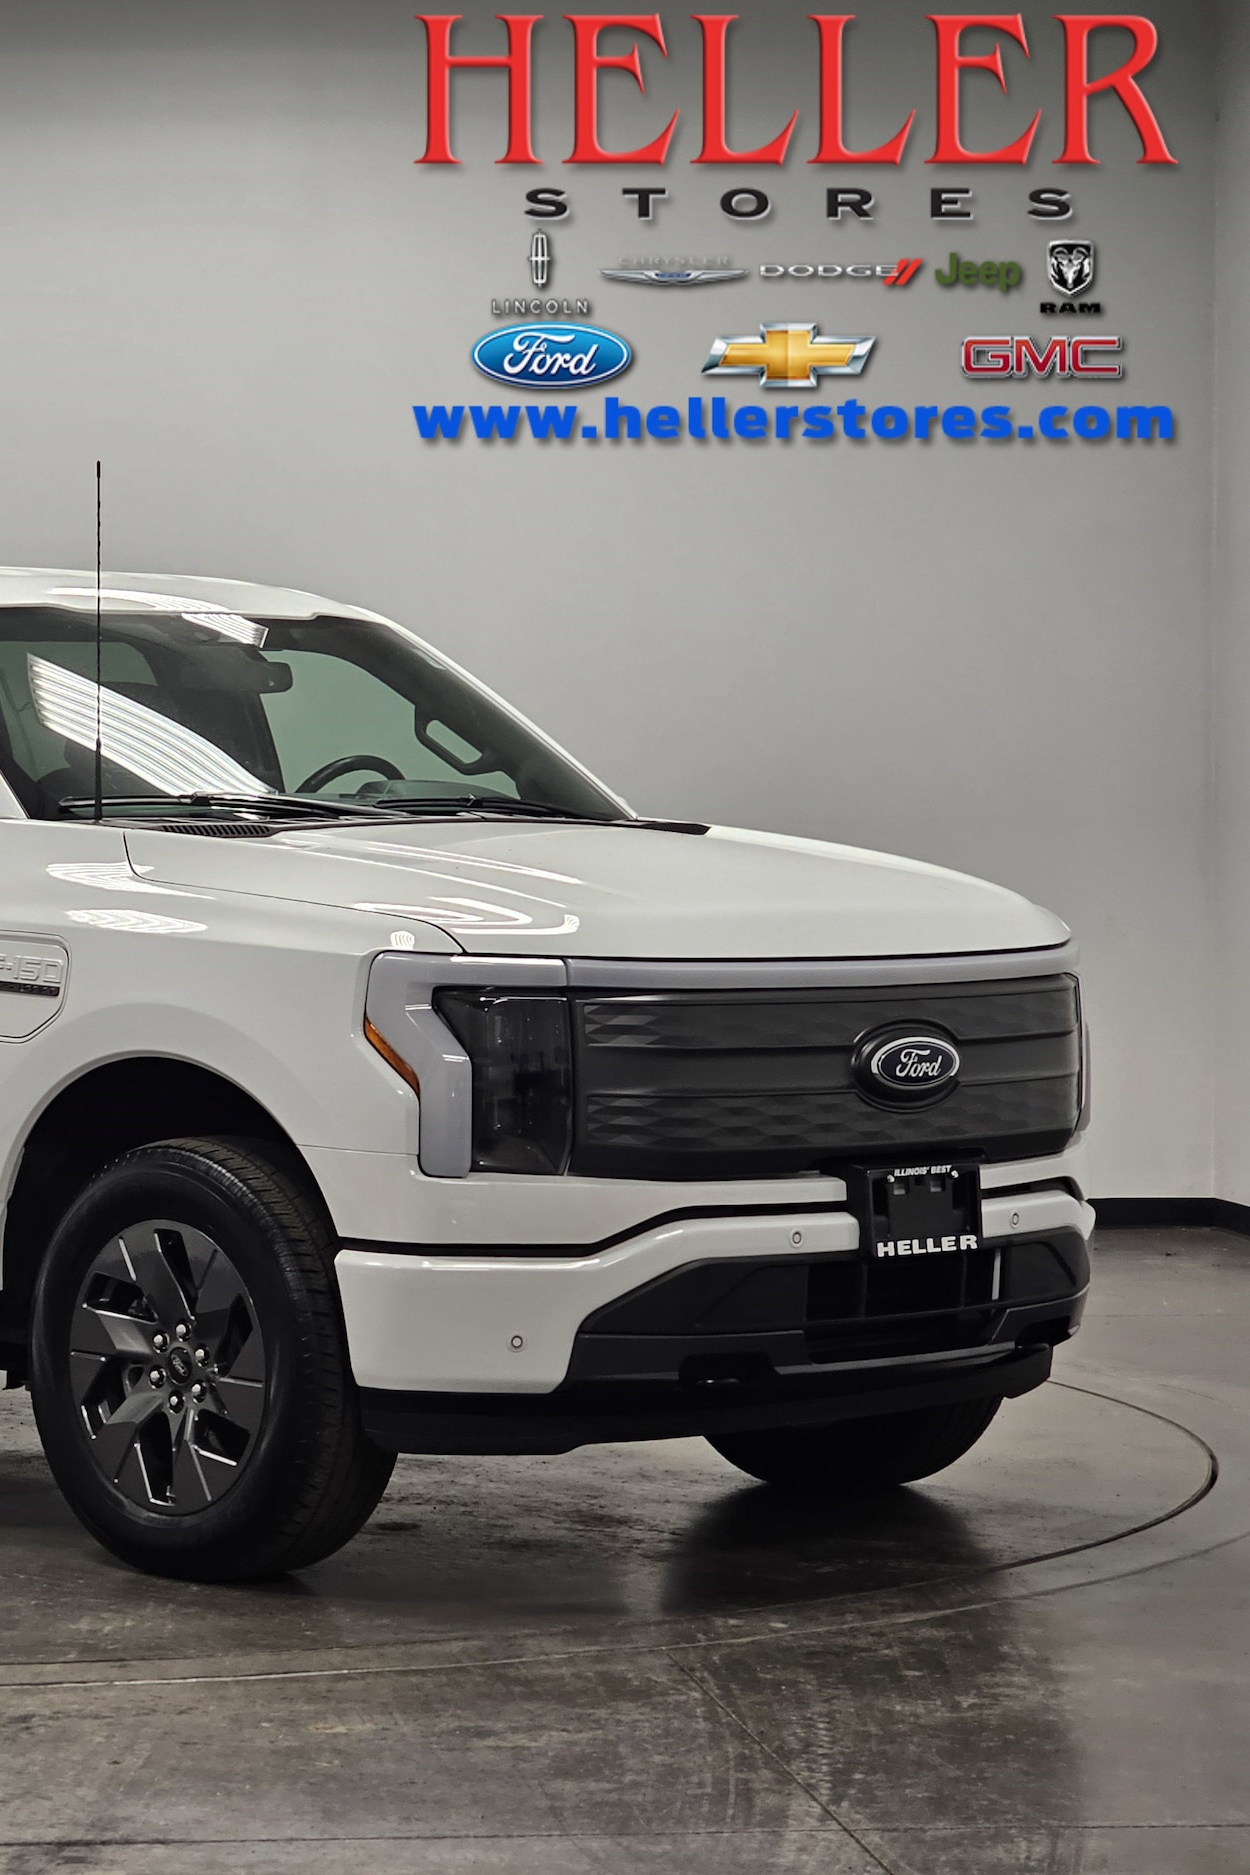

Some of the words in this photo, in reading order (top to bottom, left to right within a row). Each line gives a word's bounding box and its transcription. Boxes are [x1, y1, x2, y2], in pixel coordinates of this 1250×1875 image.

[896, 1049, 942, 1077] Ford
[931, 1165, 952, 1174] BEST
[877, 1235, 978, 1257] HELLER
